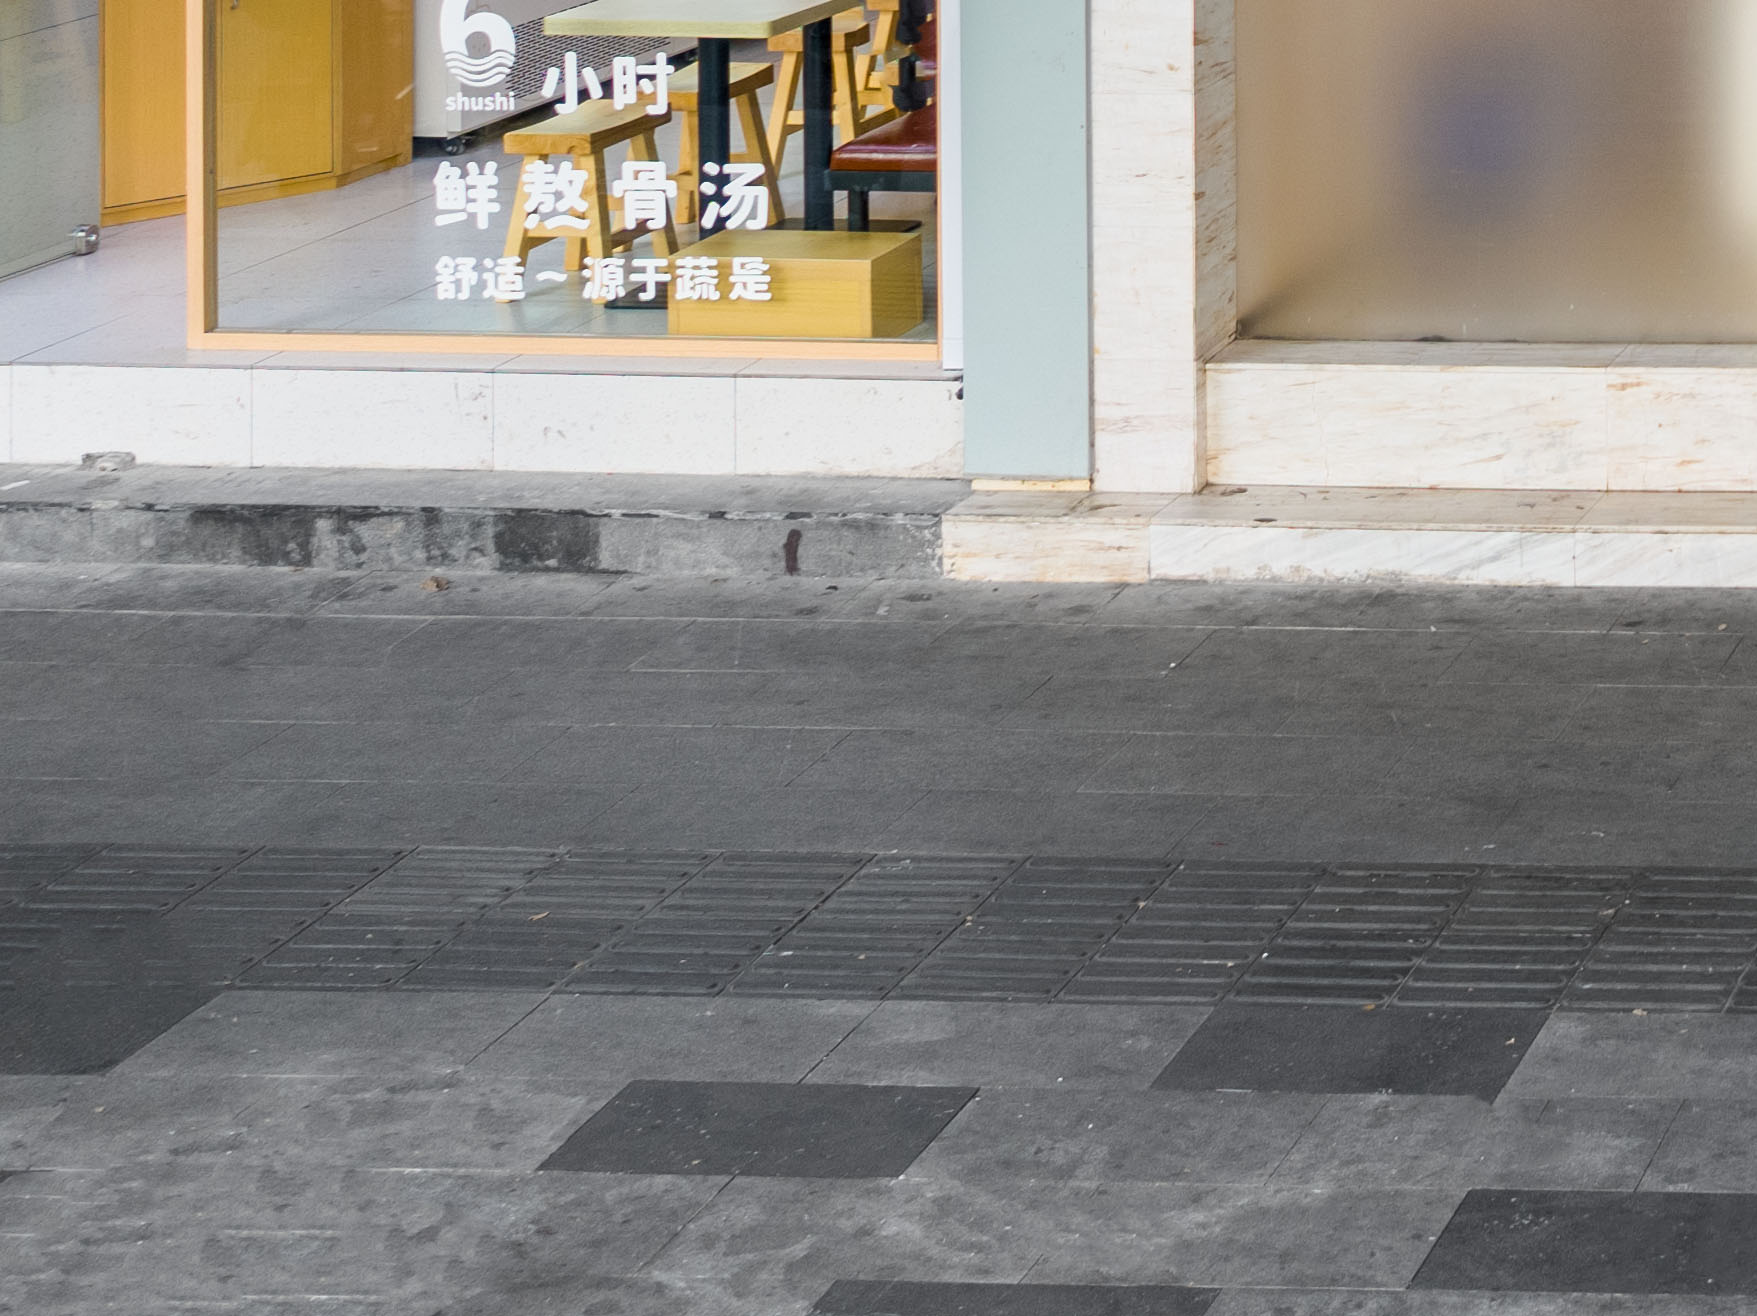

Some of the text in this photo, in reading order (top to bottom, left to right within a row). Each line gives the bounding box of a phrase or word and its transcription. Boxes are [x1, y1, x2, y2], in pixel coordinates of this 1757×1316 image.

[445, 91, 516, 112] shushi
[541, 51, 675, 116] 小时
[433, 160, 770, 231] 鲜熬骨汤
